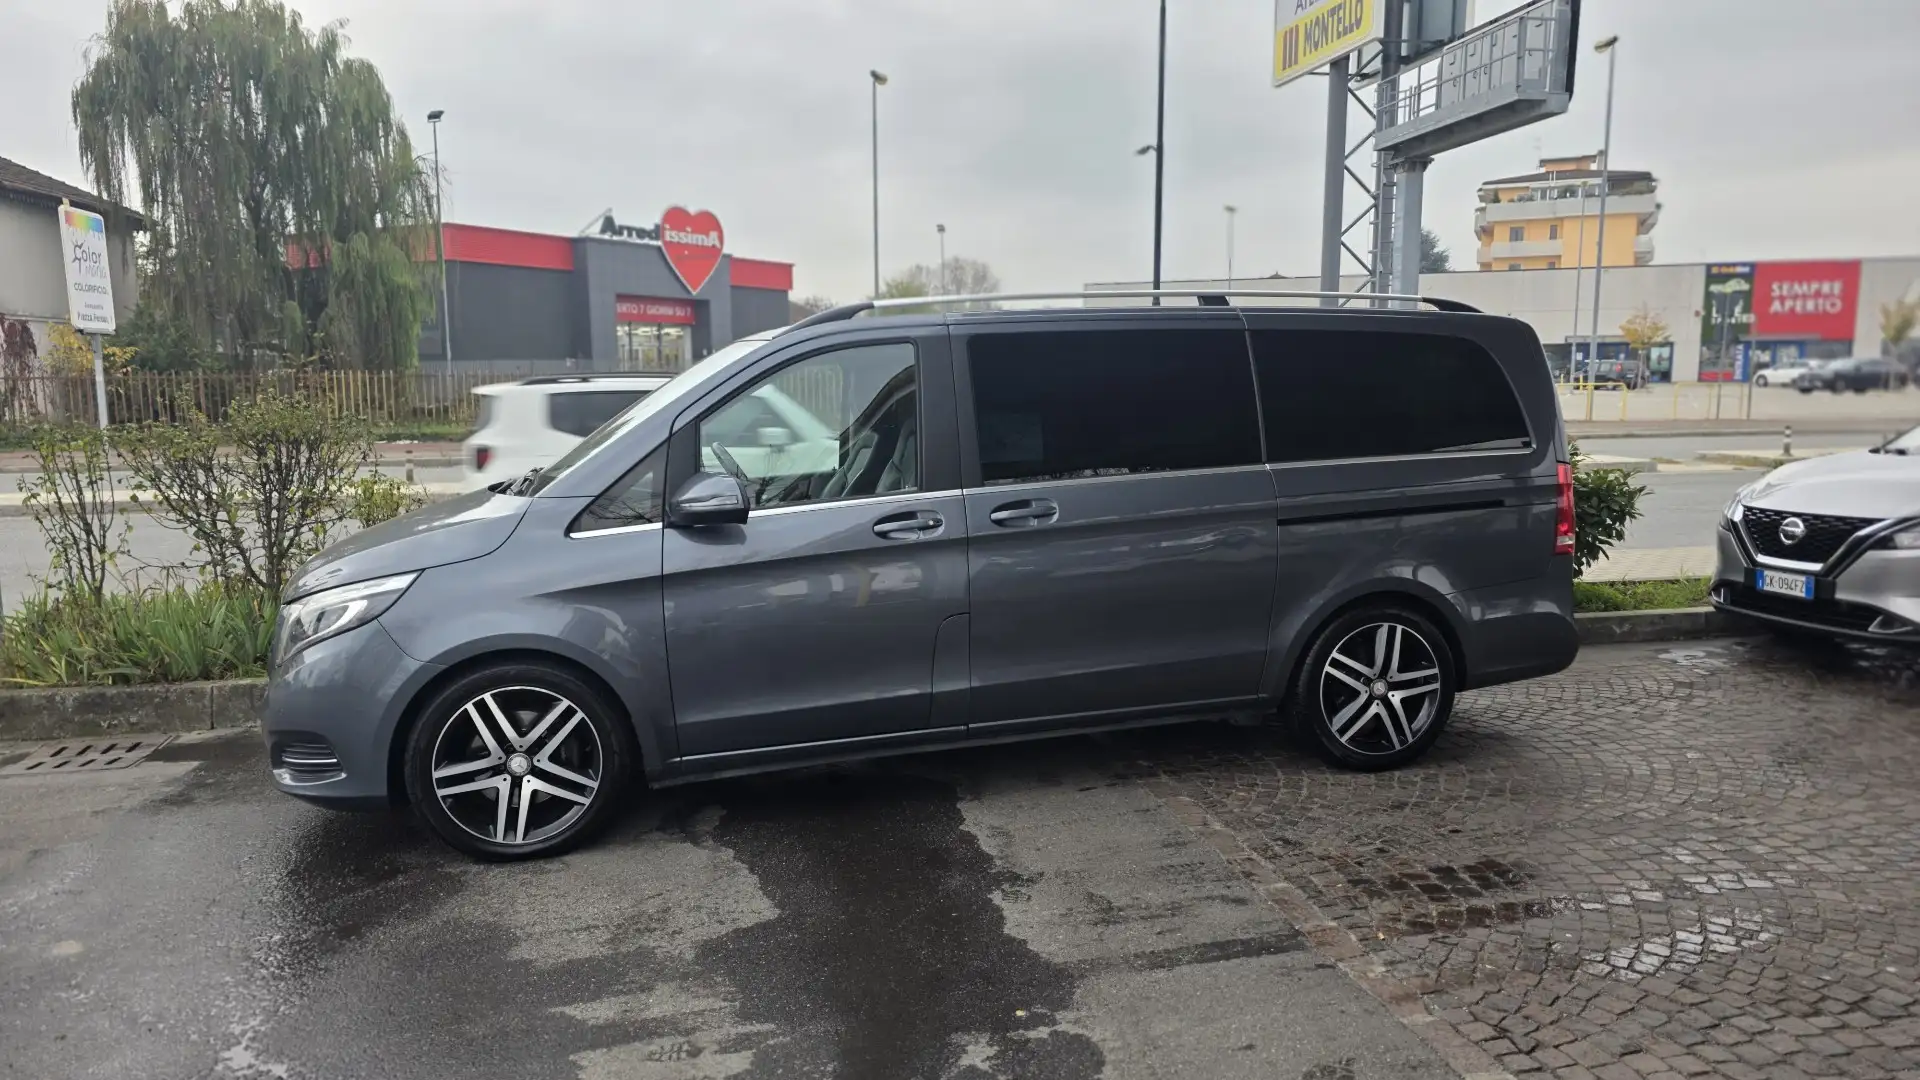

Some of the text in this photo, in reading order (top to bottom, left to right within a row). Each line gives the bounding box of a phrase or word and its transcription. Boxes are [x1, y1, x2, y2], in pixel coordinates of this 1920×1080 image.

[1303, 0, 1364, 57] MONTELLO
[1770, 280, 1843, 298] SEMPRE
[1769, 298, 1843, 315] APERTO
